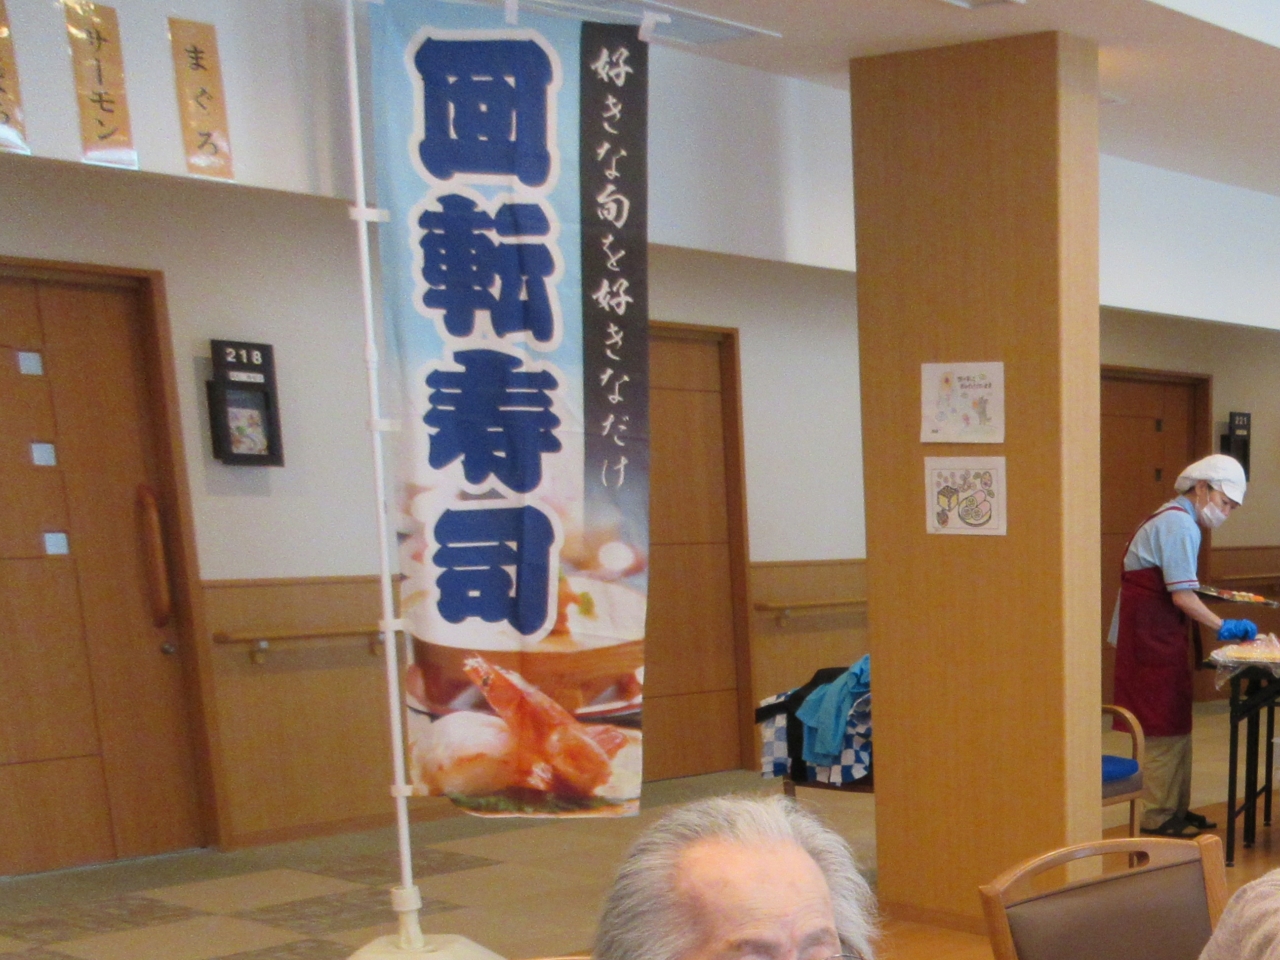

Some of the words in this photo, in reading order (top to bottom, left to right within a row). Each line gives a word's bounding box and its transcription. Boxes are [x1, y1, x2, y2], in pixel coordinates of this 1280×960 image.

[184, 44, 219, 156] まぐろ
[225, 347, 263, 365] 218
[410, 33, 566, 640] 回転寿司
[590, 46, 634, 490] 好きな旬を好きなだけ
